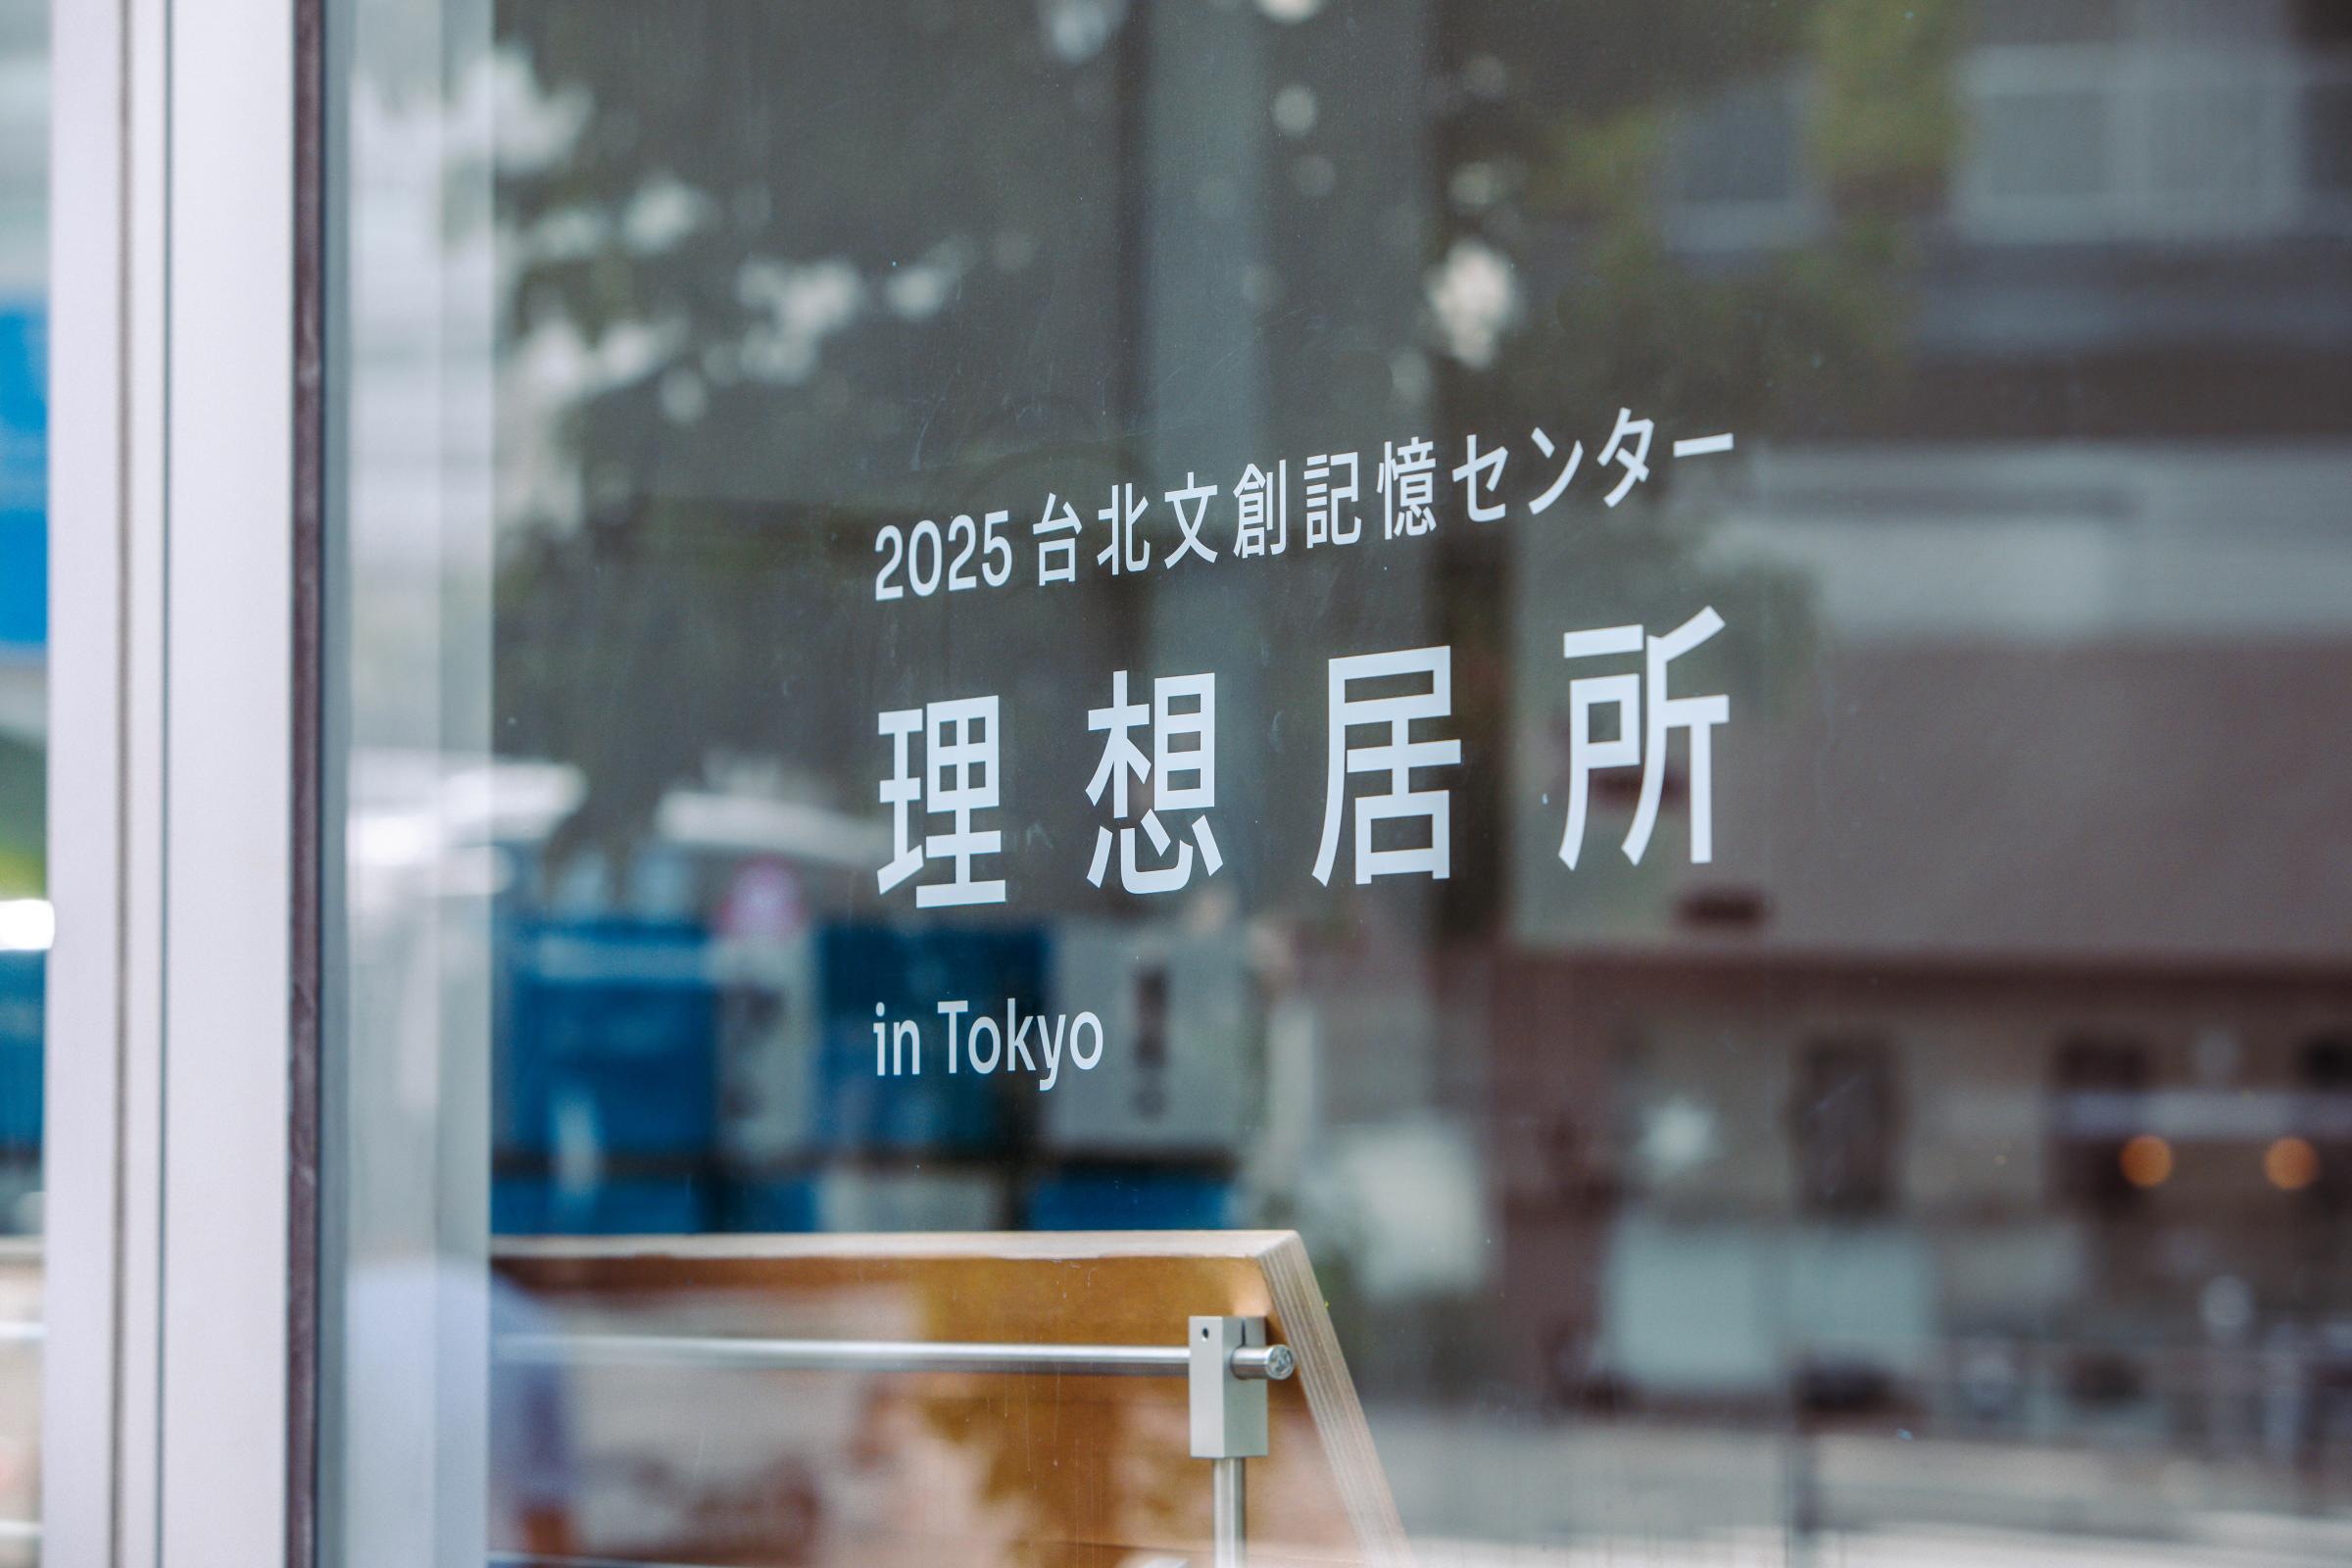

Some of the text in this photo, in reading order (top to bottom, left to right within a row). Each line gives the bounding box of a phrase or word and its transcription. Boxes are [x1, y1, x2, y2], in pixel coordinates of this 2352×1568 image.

[874, 407, 1735, 601] 2025 台北文創記憶センター
[876, 606, 1731, 908] 理想居所
[873, 998, 1104, 1092] in Tokyo
